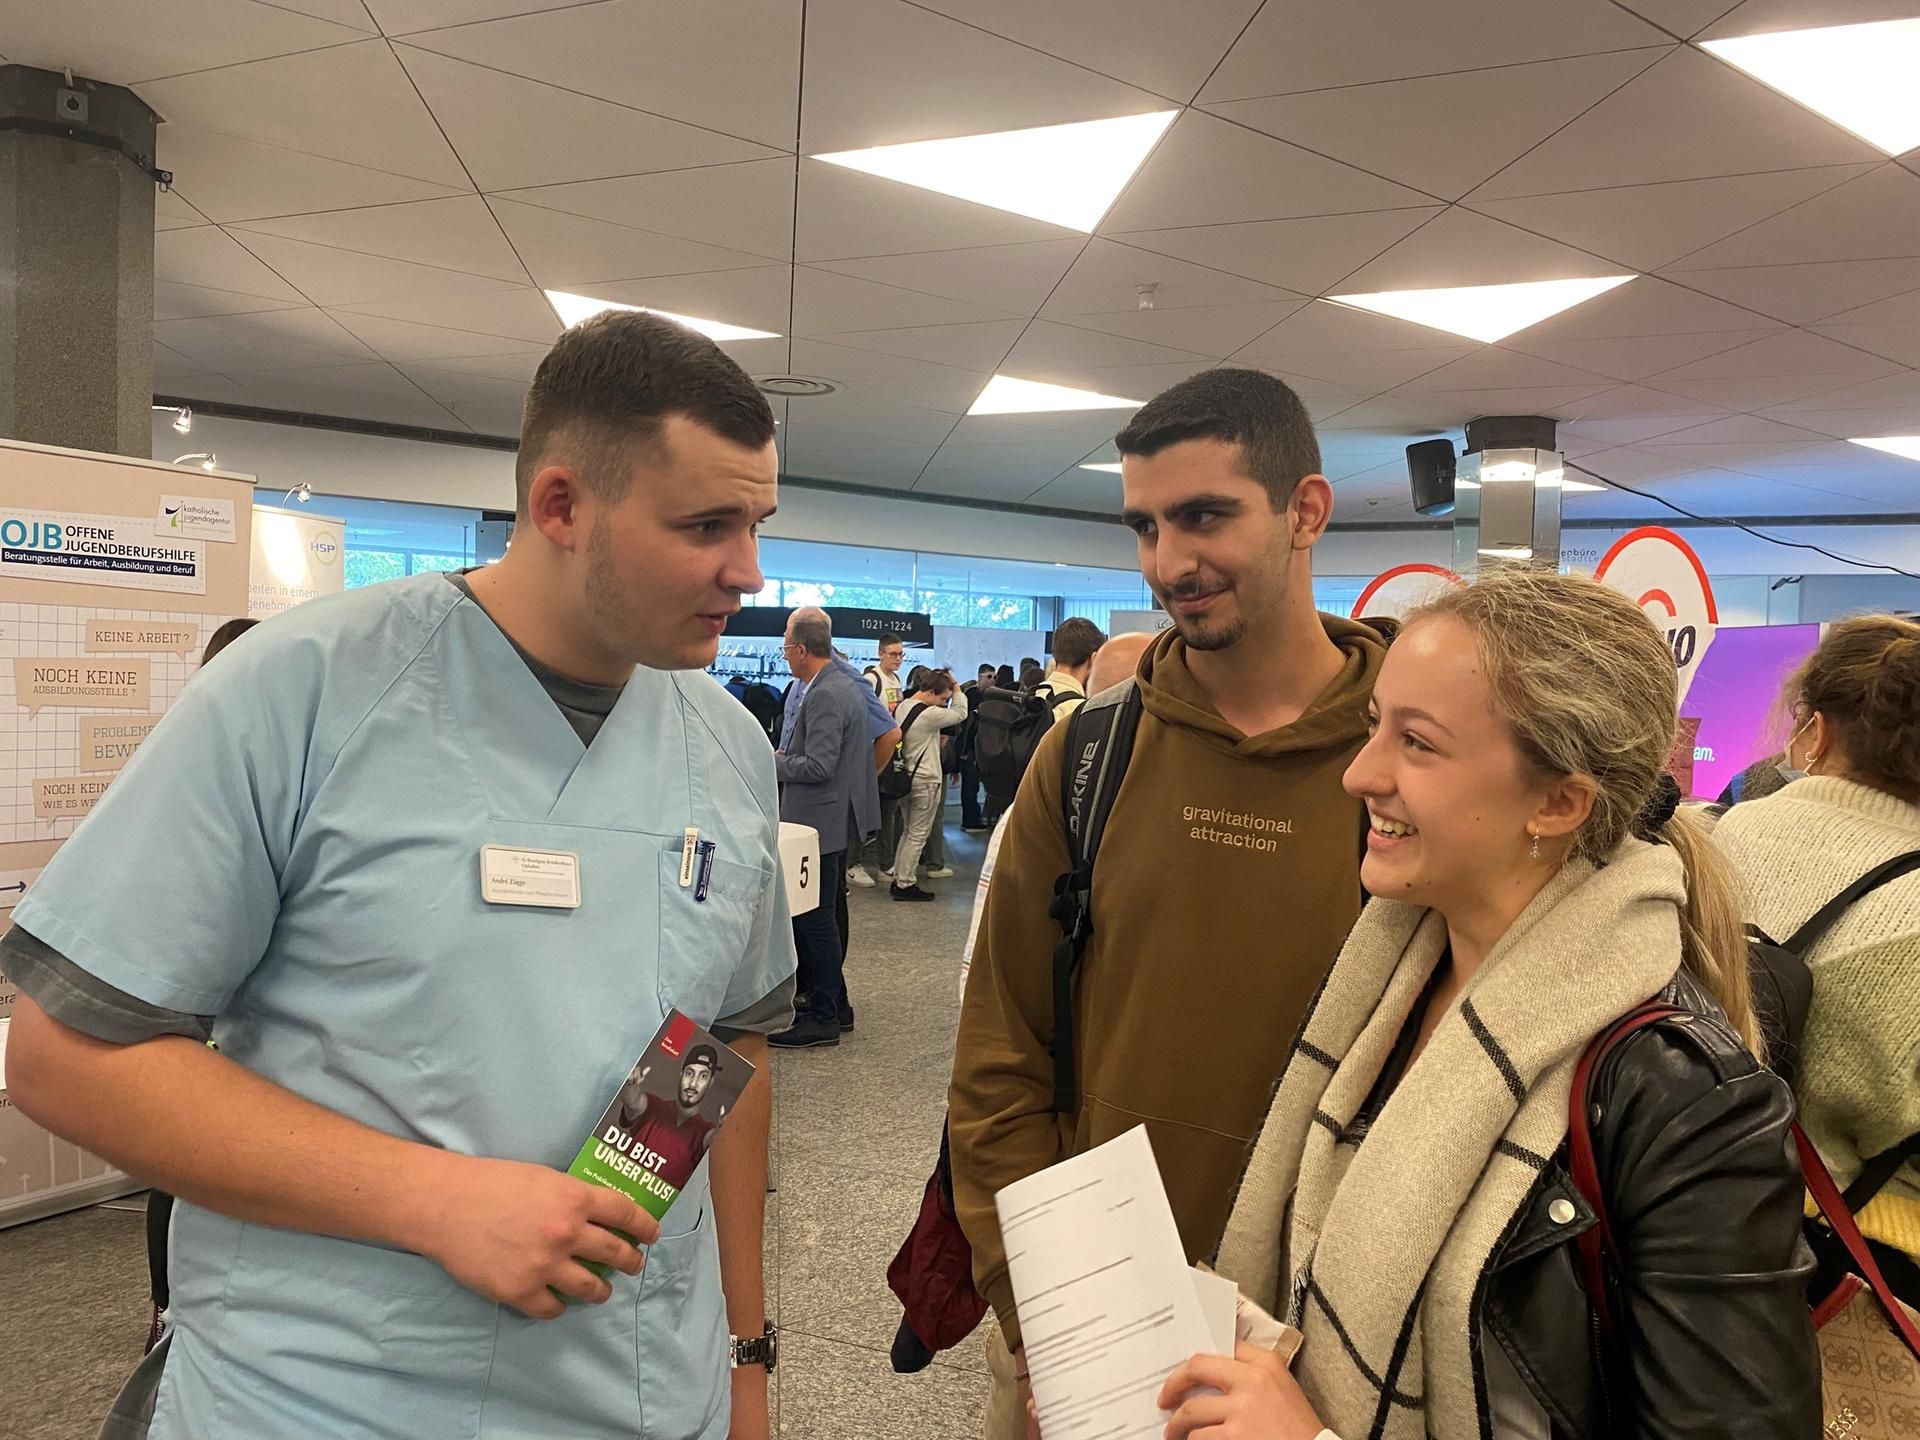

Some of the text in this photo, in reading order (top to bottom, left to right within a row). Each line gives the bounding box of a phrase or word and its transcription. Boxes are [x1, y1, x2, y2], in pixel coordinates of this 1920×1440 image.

[183, 504, 220, 515] katholische
[183, 514, 231, 525] jugendagentur
[1, 519, 62, 550] OJB
[65, 525, 115, 541] OFFENE
[64, 540, 196, 562] JUGENDBERUFSHILFE
[310, 541, 336, 553] HSP
[4, 552, 194, 575] Beratungsstelle für Arbeit, Ausbildung und Beruf
[279, 585, 288, 596] in
[290, 587, 319, 598] einem
[860, 618, 912, 632] 1021-1224
[95, 631, 134, 643] KEINE
[33, 667, 137, 685] NOCH KEINE
[43, 783, 76, 796] NOCH
[1069, 738, 1101, 838] DAKINE
[43, 800, 63, 809] WIE
[65, 799, 78, 808] ES
[1182, 804, 1293, 834] gravitational
[1189, 824, 1278, 853] attraction
[799, 855, 809, 889] 5
[602, 1125, 668, 1174] DU BIST
[593, 1143, 676, 1202] UNSER PLUS!
